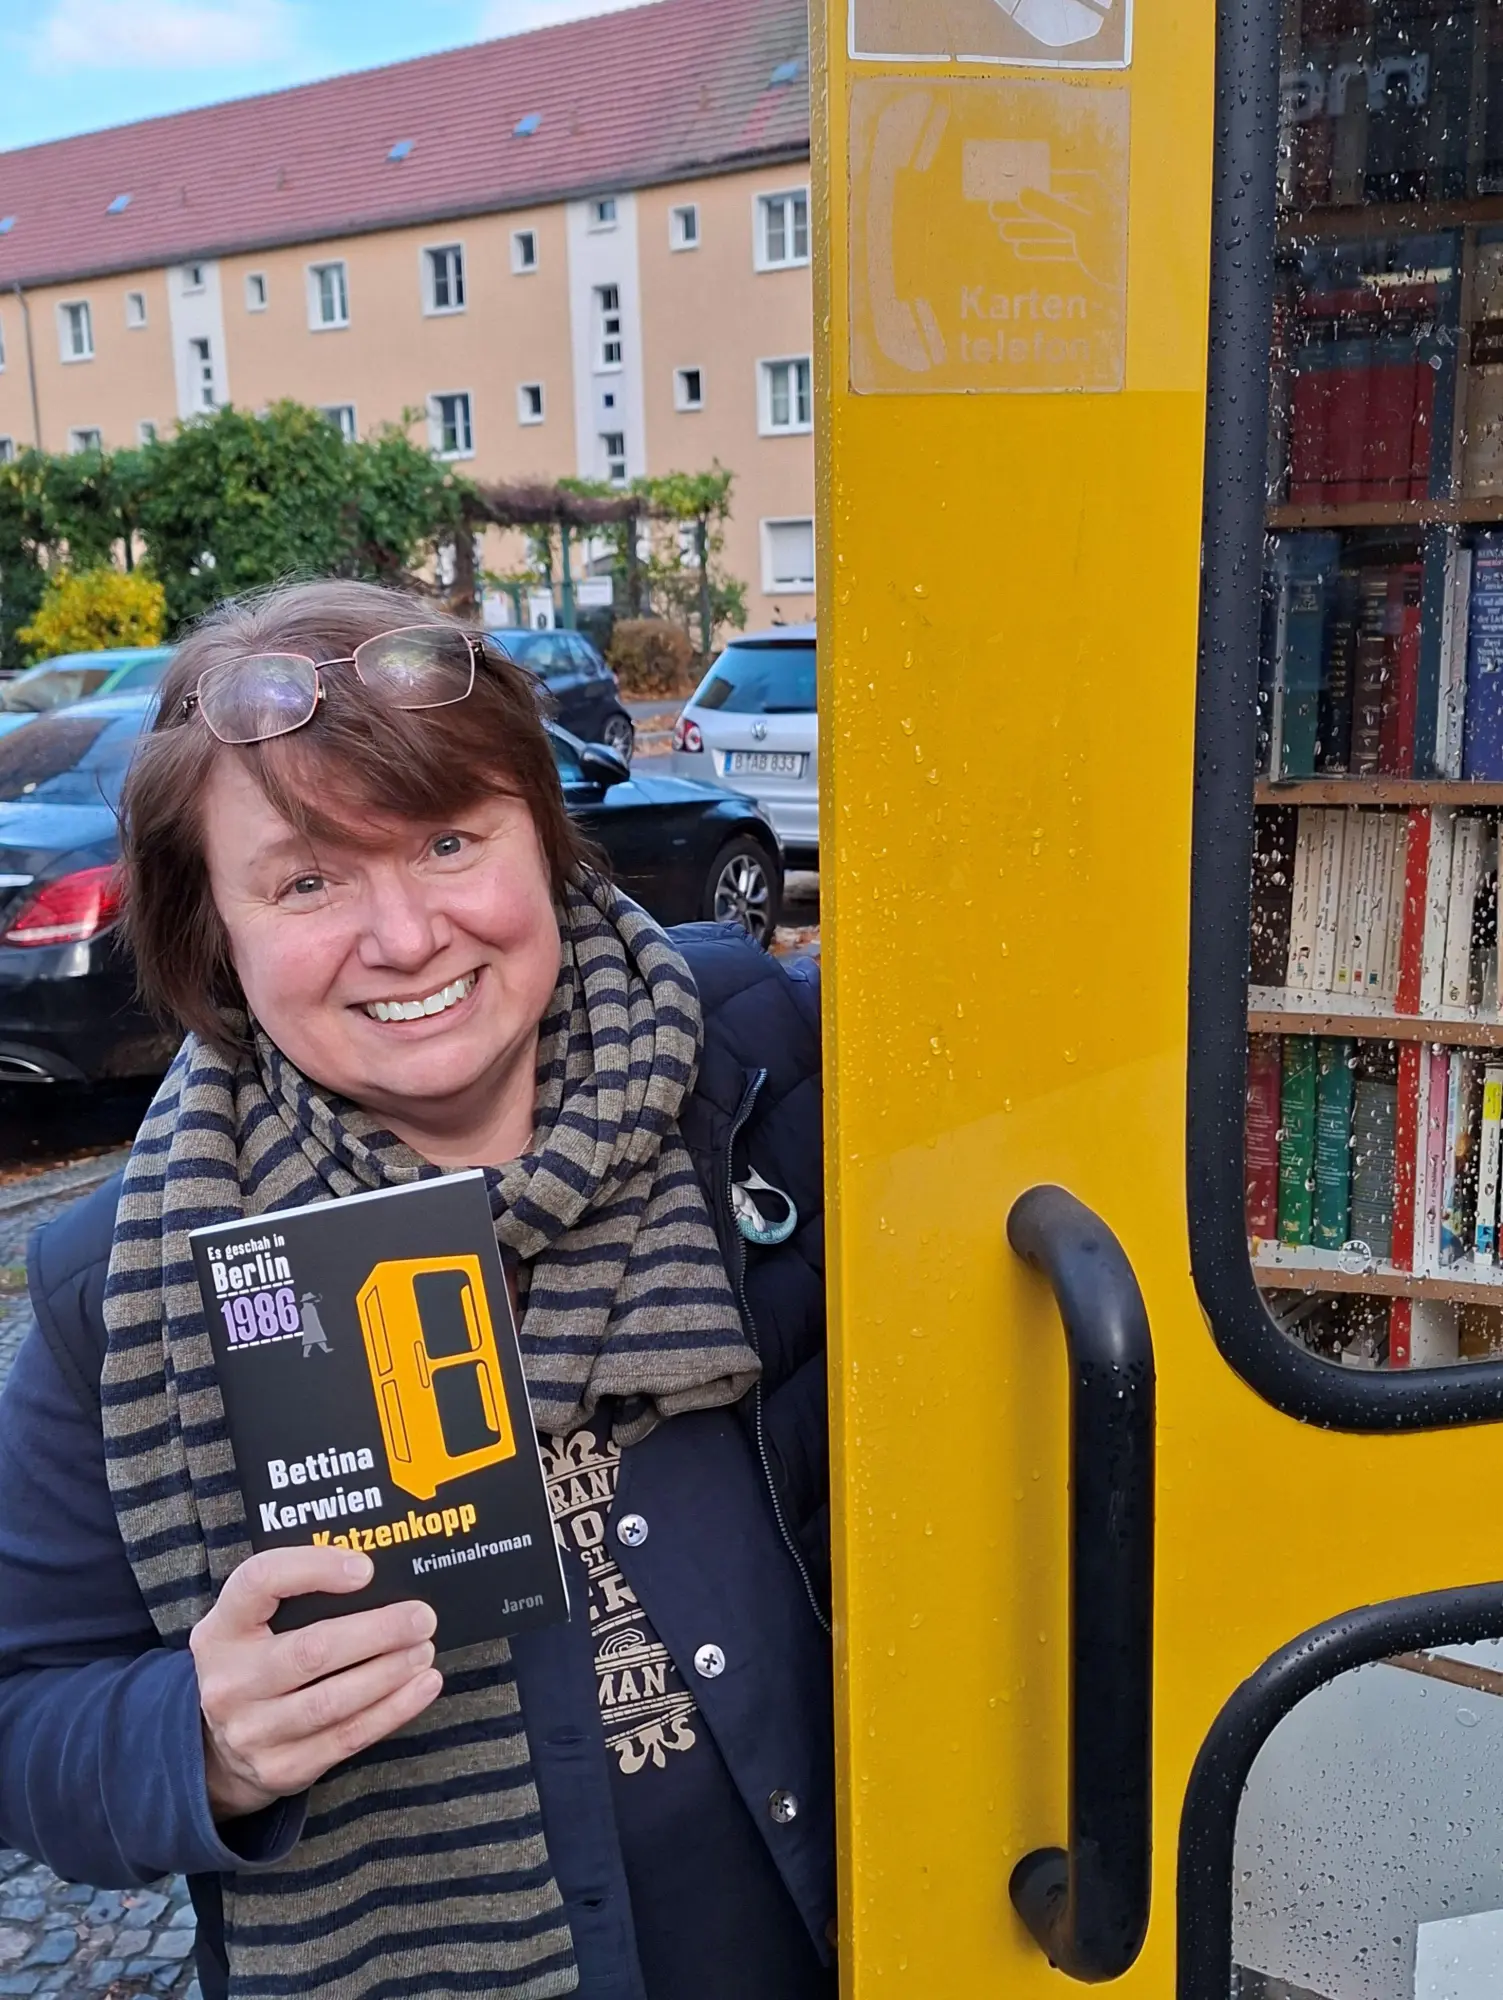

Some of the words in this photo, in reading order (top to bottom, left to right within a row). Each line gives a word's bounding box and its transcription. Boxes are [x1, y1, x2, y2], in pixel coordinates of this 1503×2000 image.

[960, 330, 1091, 364] telefon
[207, 1246, 222, 1261] Es
[225, 1235, 271, 1261] geschah
[273, 1233, 285, 1248] in
[211, 1252, 291, 1293] Berlin
[220, 1287, 300, 1343] 1986
[267, 1447, 374, 1490] Bettina
[547, 1466, 620, 1513] RAN
[259, 1486, 383, 1532] Kerwien
[412, 1533, 532, 1575] Kriminalroman
[501, 1594, 544, 1614] Jaron
